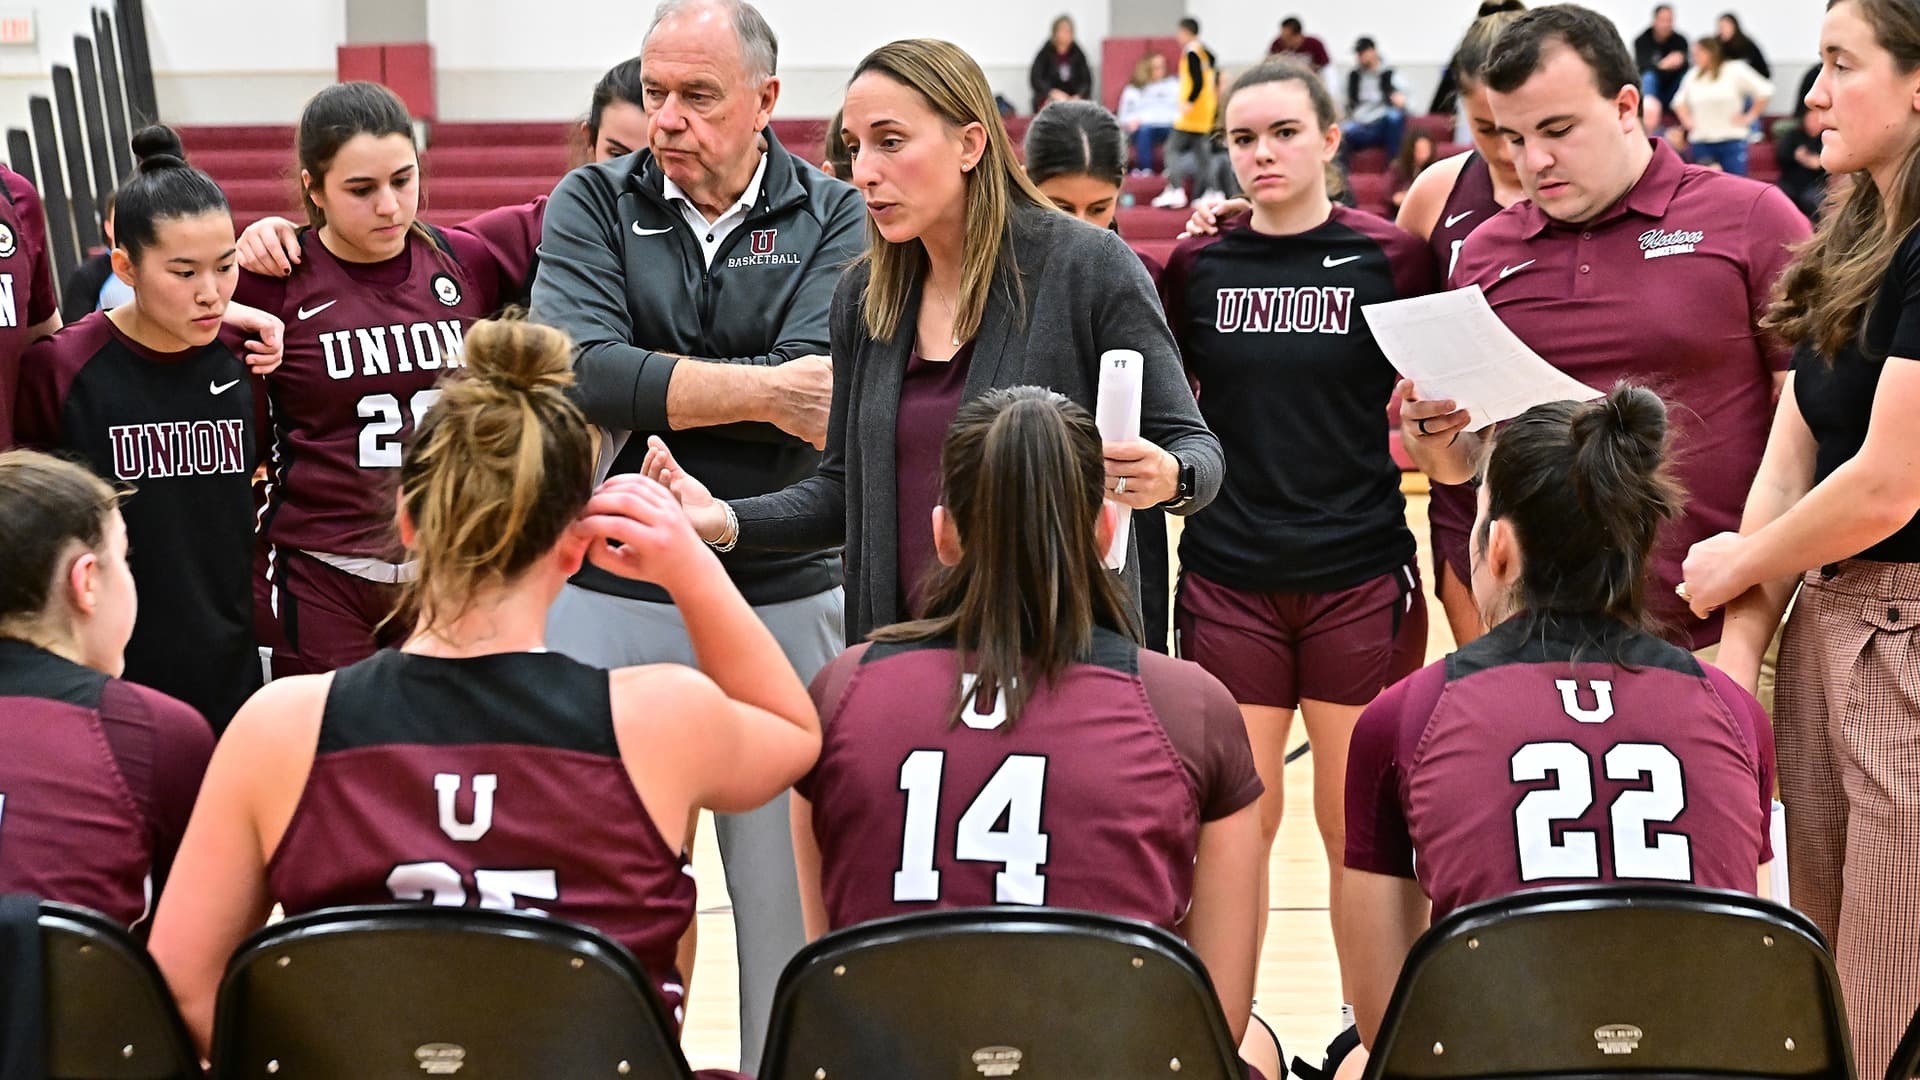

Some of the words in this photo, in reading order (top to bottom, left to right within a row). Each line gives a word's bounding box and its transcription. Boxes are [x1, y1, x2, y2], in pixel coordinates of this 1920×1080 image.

[727, 253, 801, 268] BASKETBALL
[750, 228, 778, 256] U
[1637, 228, 1705, 250] Union
[1215, 286, 1355, 335] UNION
[318, 319, 468, 380] UNION
[108, 419, 245, 481] UNION
[1553, 678, 1616, 725] U
[433, 772, 498, 842] U
[892, 749, 1049, 907] 14
[1509, 739, 1694, 882] 22
